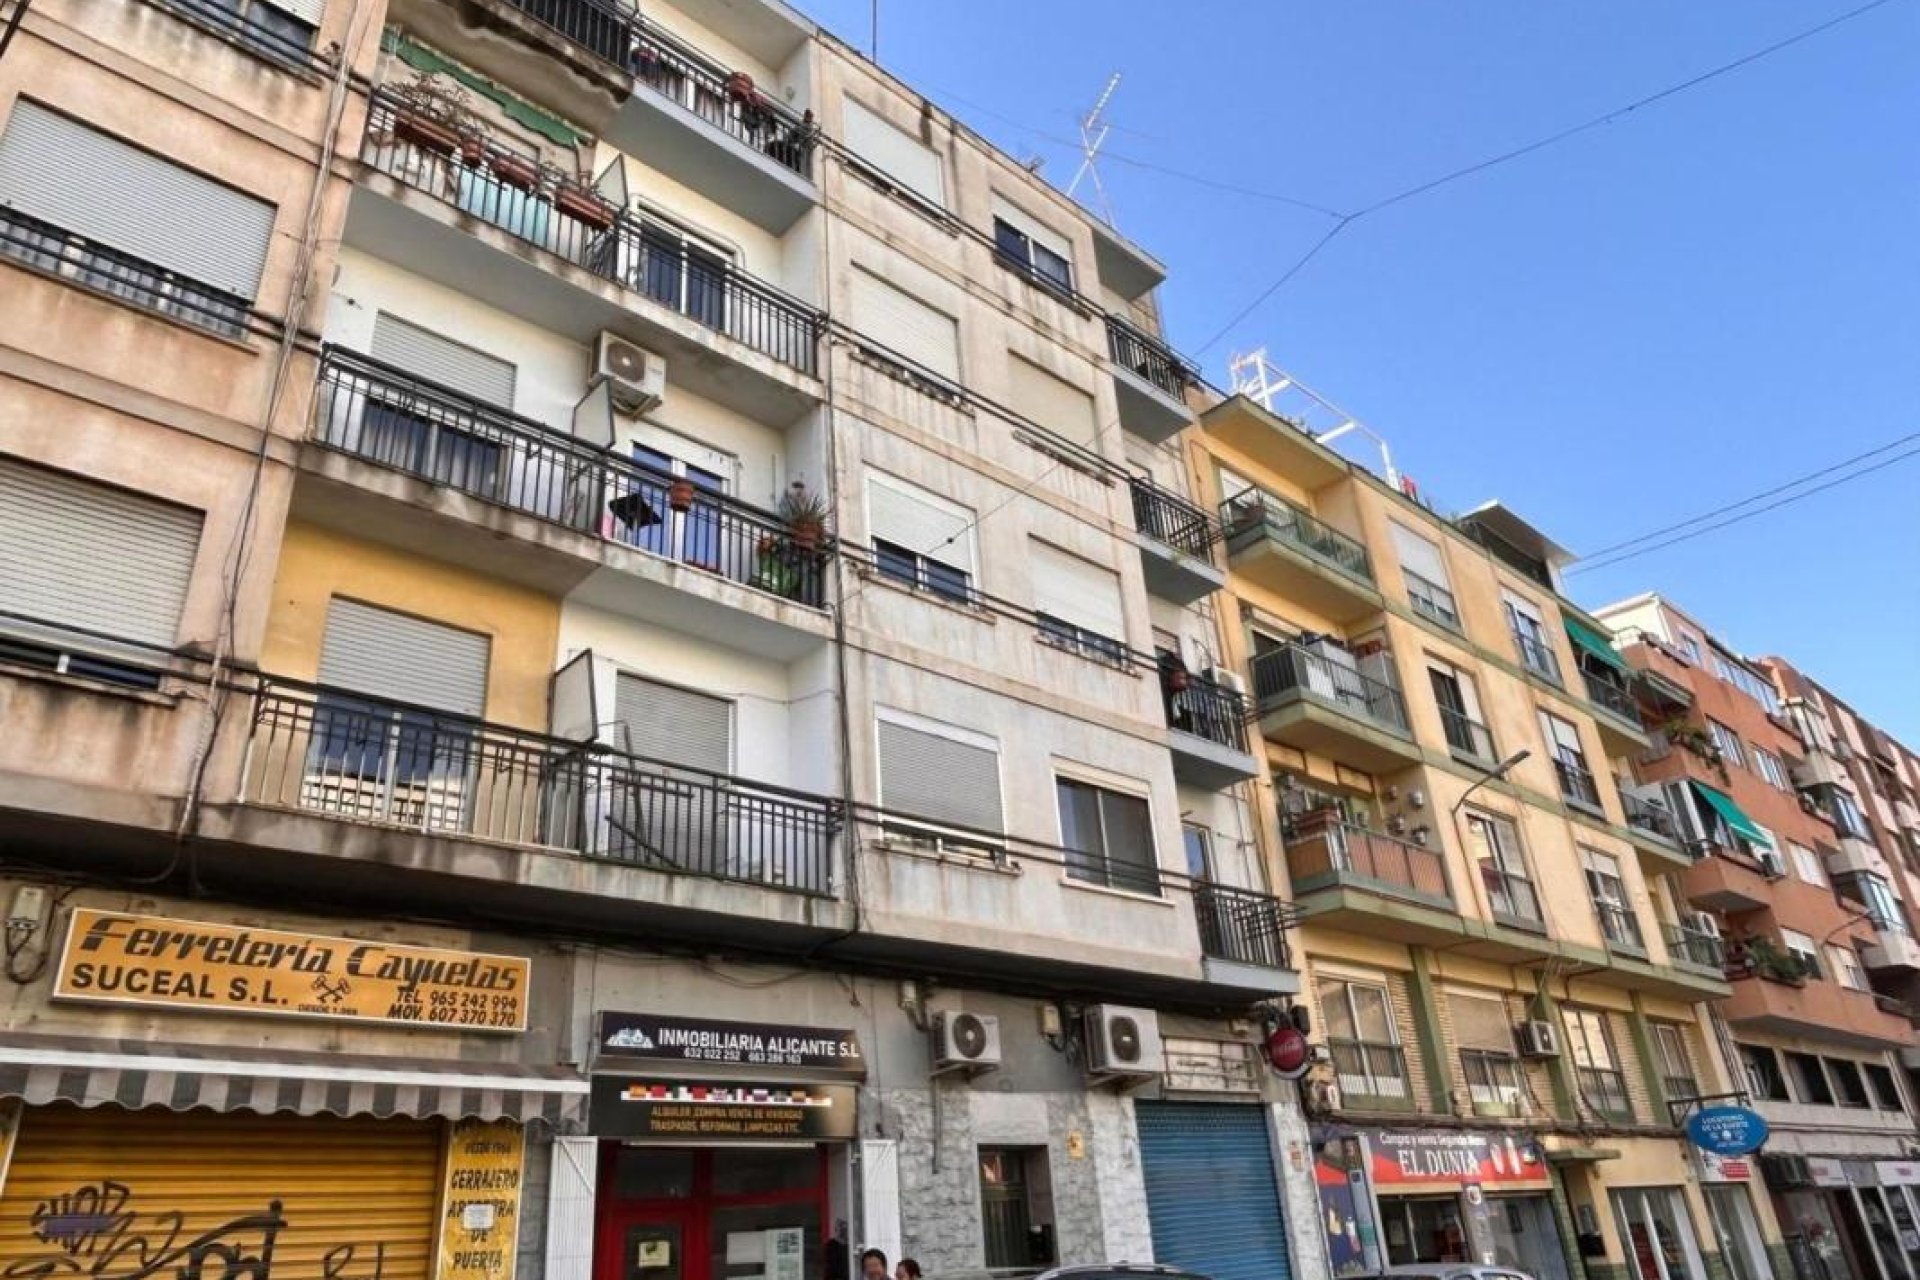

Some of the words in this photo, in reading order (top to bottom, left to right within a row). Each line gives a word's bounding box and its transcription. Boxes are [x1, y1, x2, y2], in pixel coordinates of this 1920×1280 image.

[346, 946, 520, 992] Cayuelas
[71, 963, 214, 999] SUCEAL
[228, 977, 289, 1005] S.L.
[429, 992, 458, 1006] 965
[461, 993, 486, 1010] 242
[429, 1008, 457, 1022] 607
[460, 1009, 486, 1025] 370
[489, 1012, 516, 1028] 370
[658, 1027, 763, 1051] INMOBILIARIA
[769, 1038, 836, 1057] ALICANTE
[1397, 1149, 1424, 1177] EL
[1427, 1149, 1482, 1176] DUNIA
[451, 1168, 518, 1190] CERRAJERO
[453, 1250, 502, 1270] PUERTA
